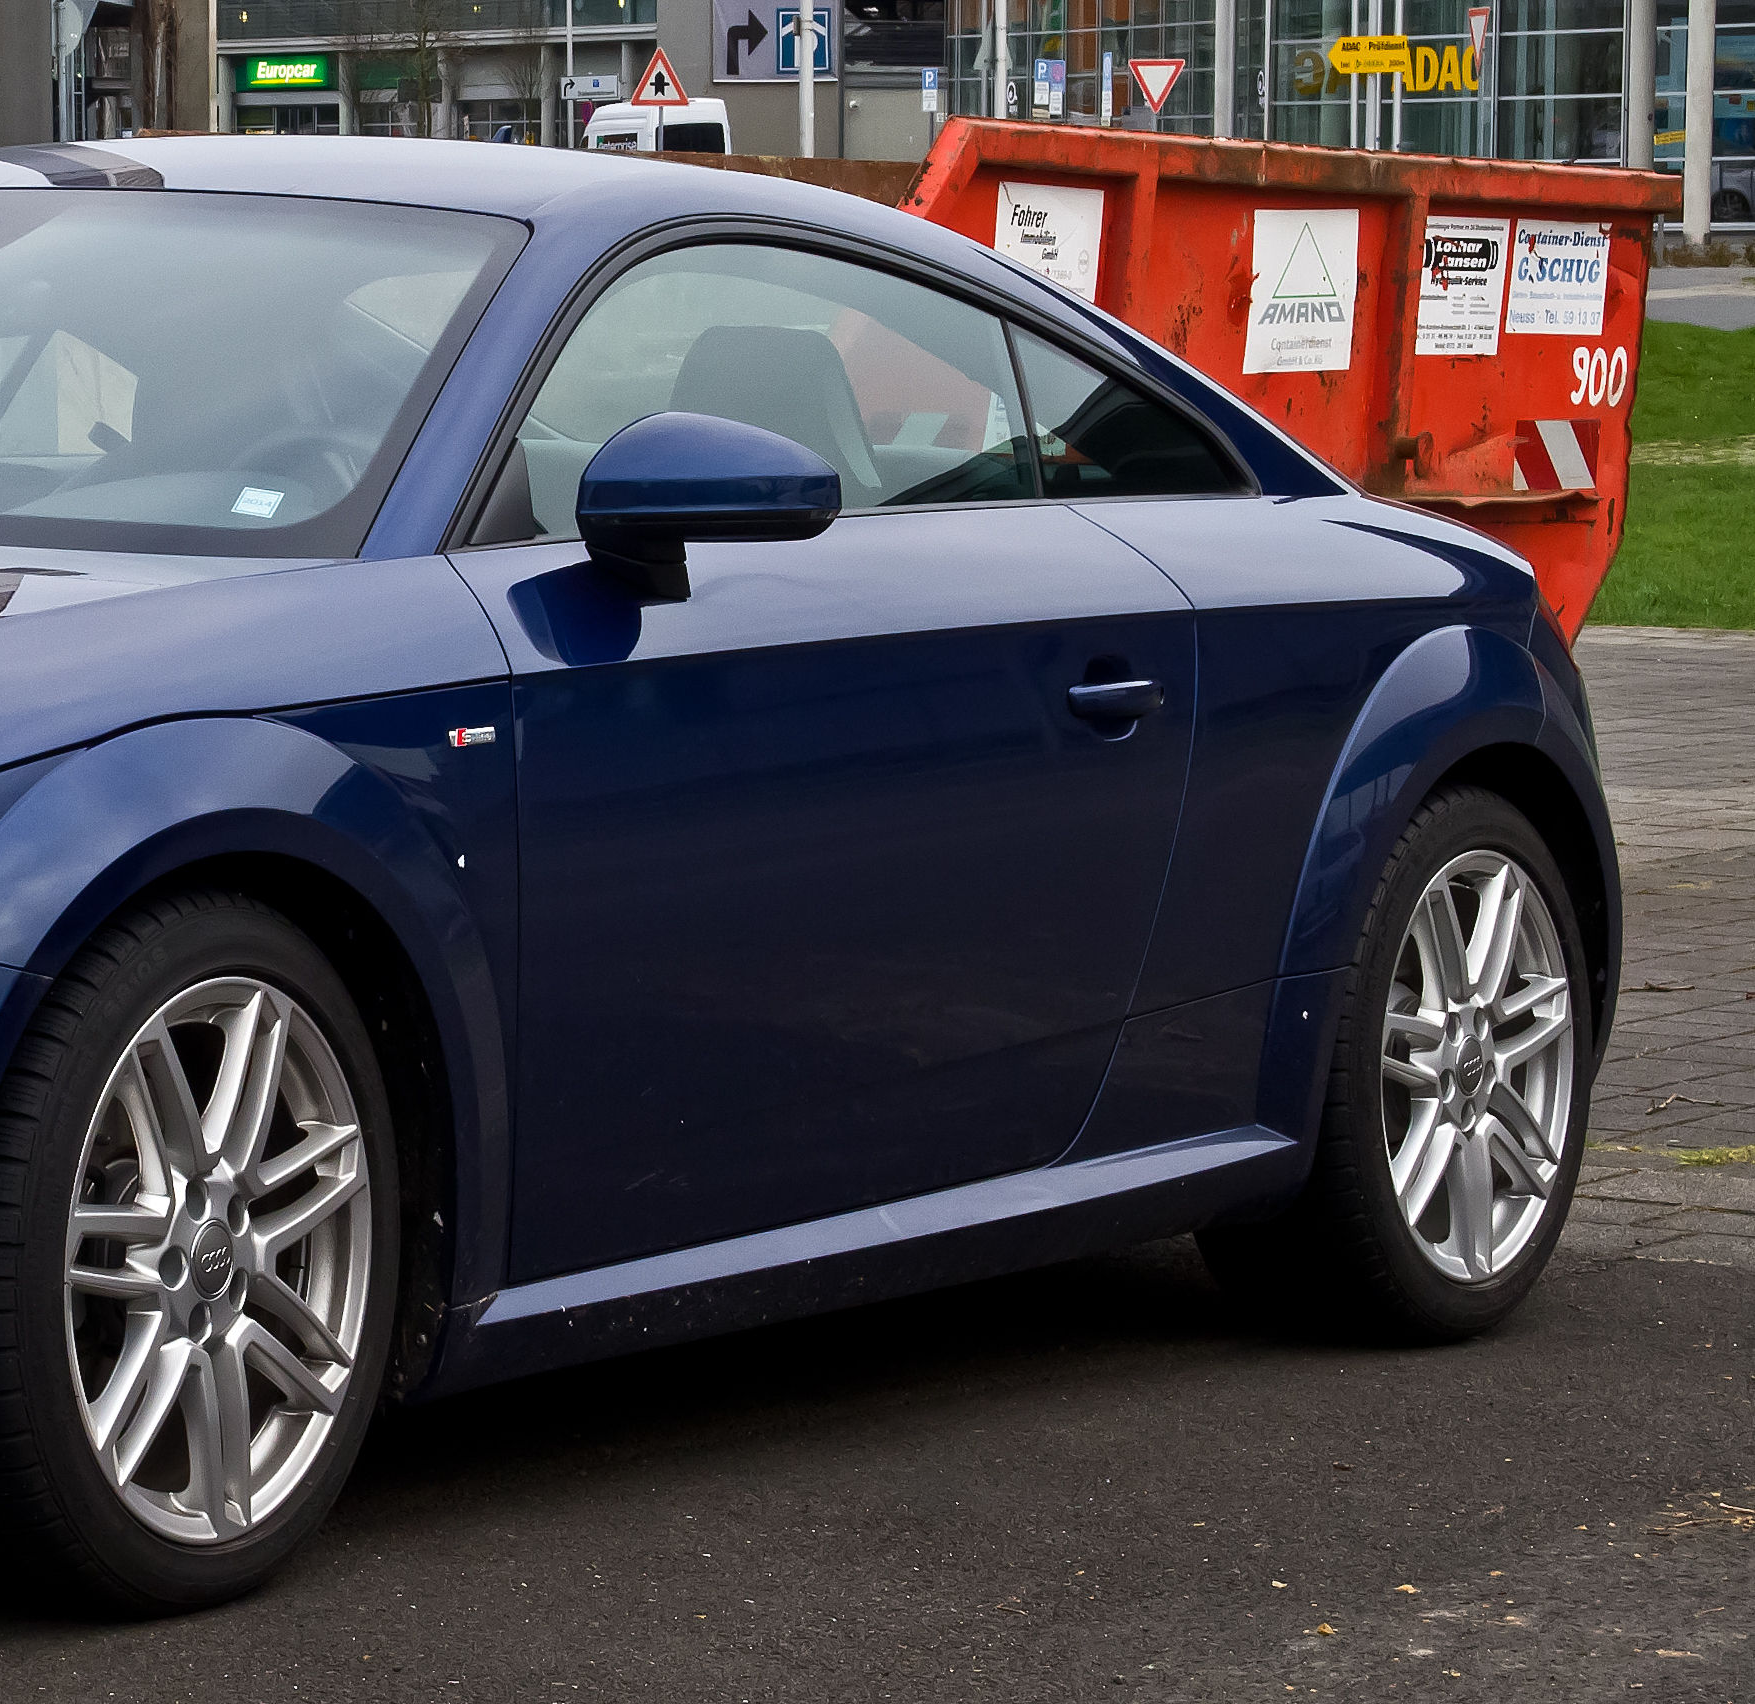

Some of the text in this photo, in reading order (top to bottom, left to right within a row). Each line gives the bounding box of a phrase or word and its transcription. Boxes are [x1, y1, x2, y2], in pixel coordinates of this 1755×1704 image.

[256, 61, 317, 84] Europcar
[925, 71, 934, 87] P
[1391, 46, 1478, 92] ADAC
[1010, 204, 1049, 228] Fohrer
[1435, 240, 1483, 253] Lothar
[1536, 257, 1600, 284] SCHUG
[1257, 301, 1346, 326] AMANO
[1509, 309, 1535, 324] Neuss
[1545, 308, 1560, 325] Tel.
[1570, 346, 1628, 408] 900
